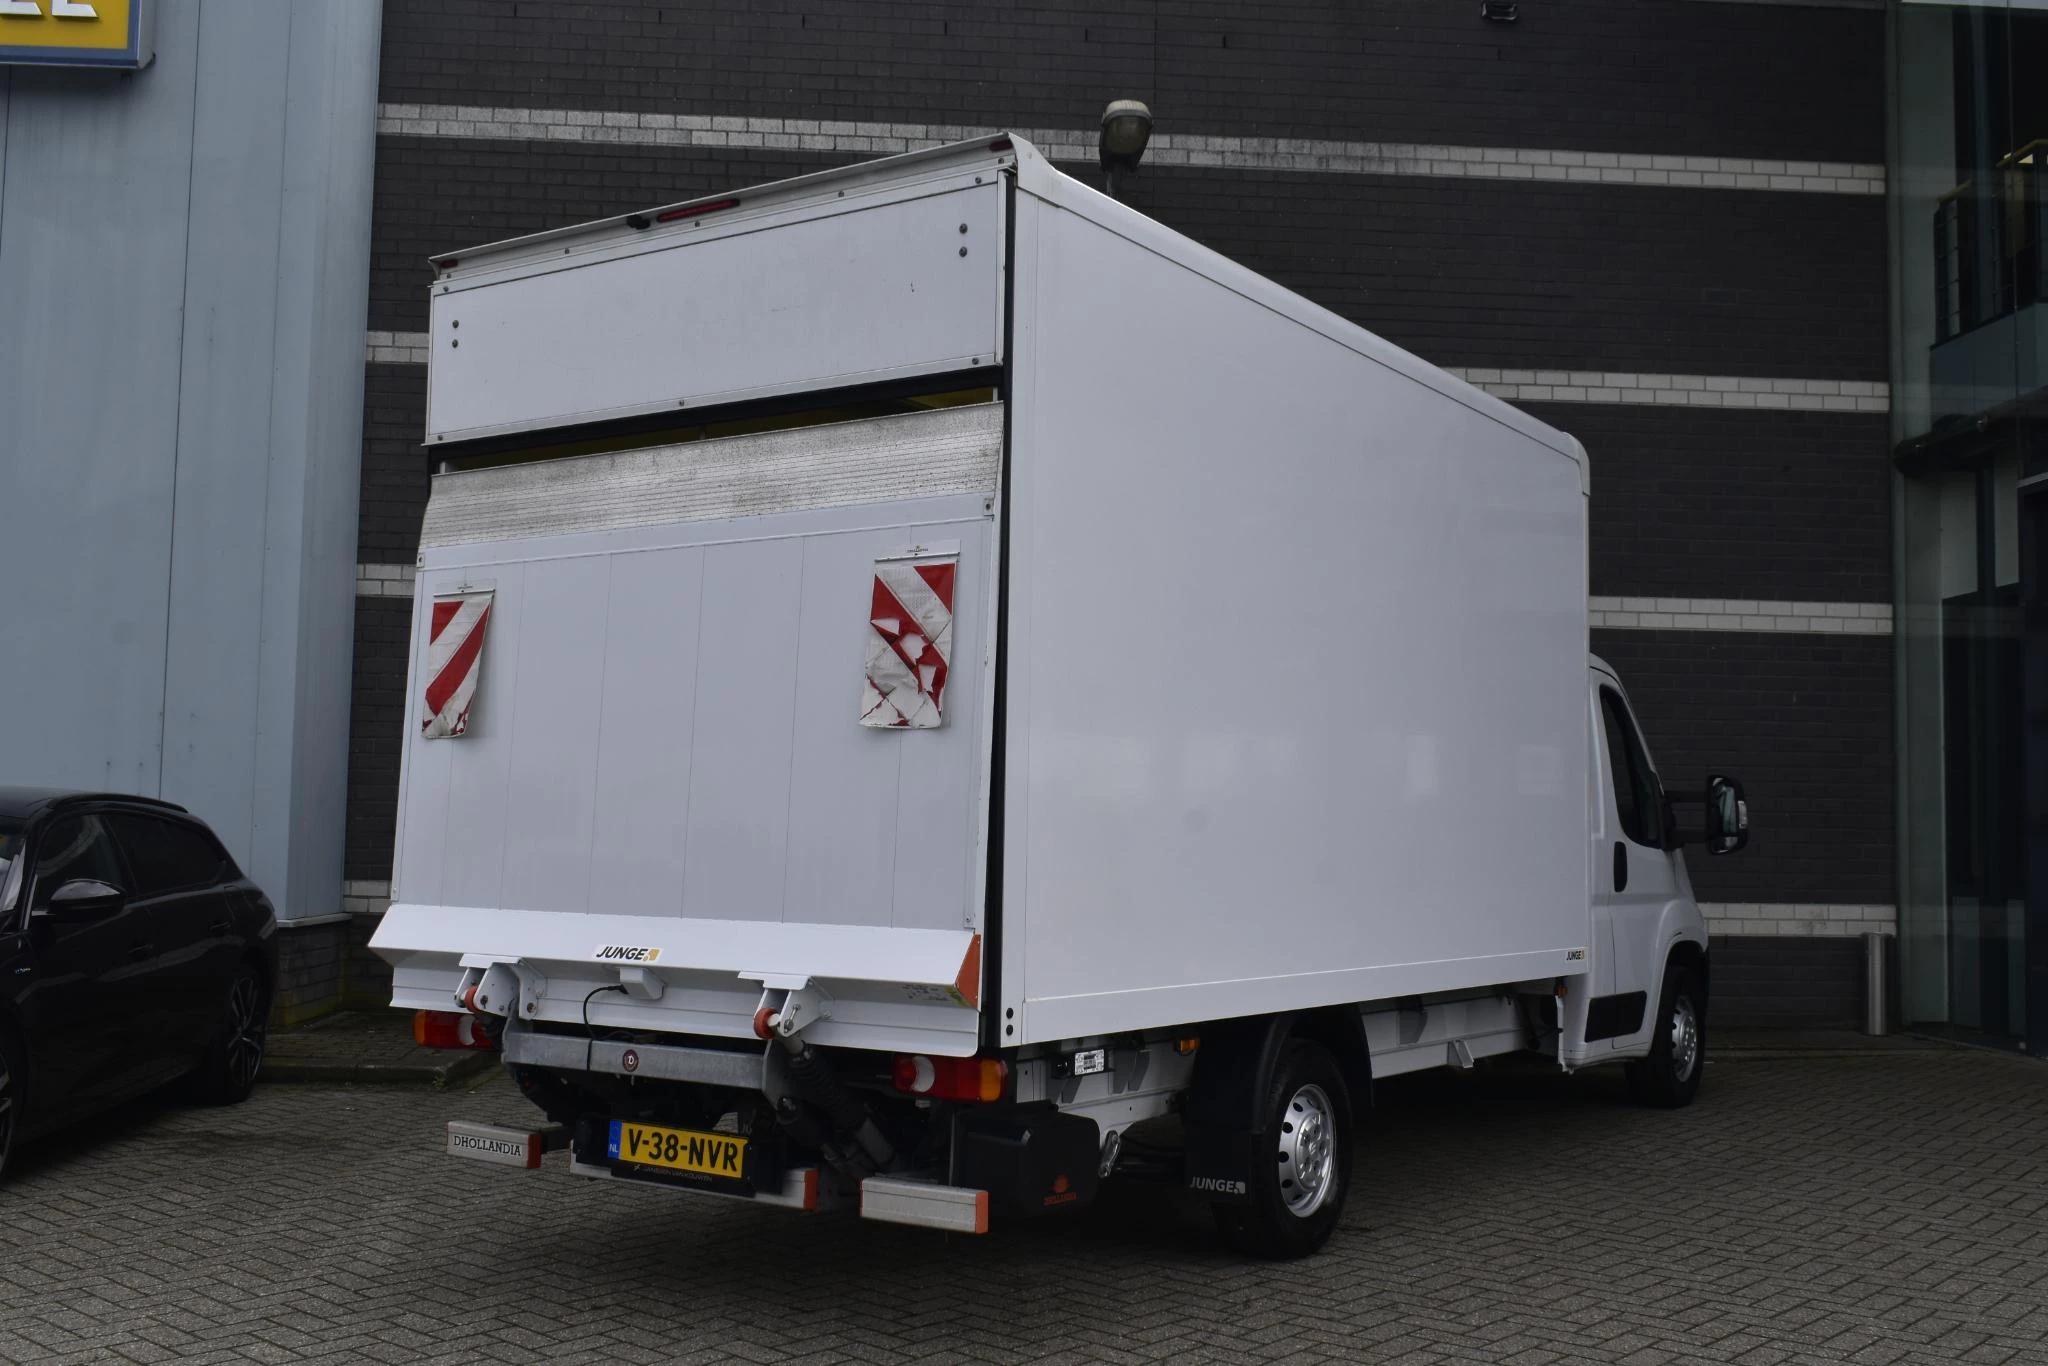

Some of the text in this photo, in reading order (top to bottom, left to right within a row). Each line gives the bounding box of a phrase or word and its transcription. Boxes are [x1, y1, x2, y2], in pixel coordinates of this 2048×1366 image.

[596, 946, 649, 960] JUNGE
[454, 1136, 522, 1156] DHOLLANDIA
[609, 1128, 738, 1172] NL V-38-NVR
[1189, 1176, 1235, 1193] JUNGE
